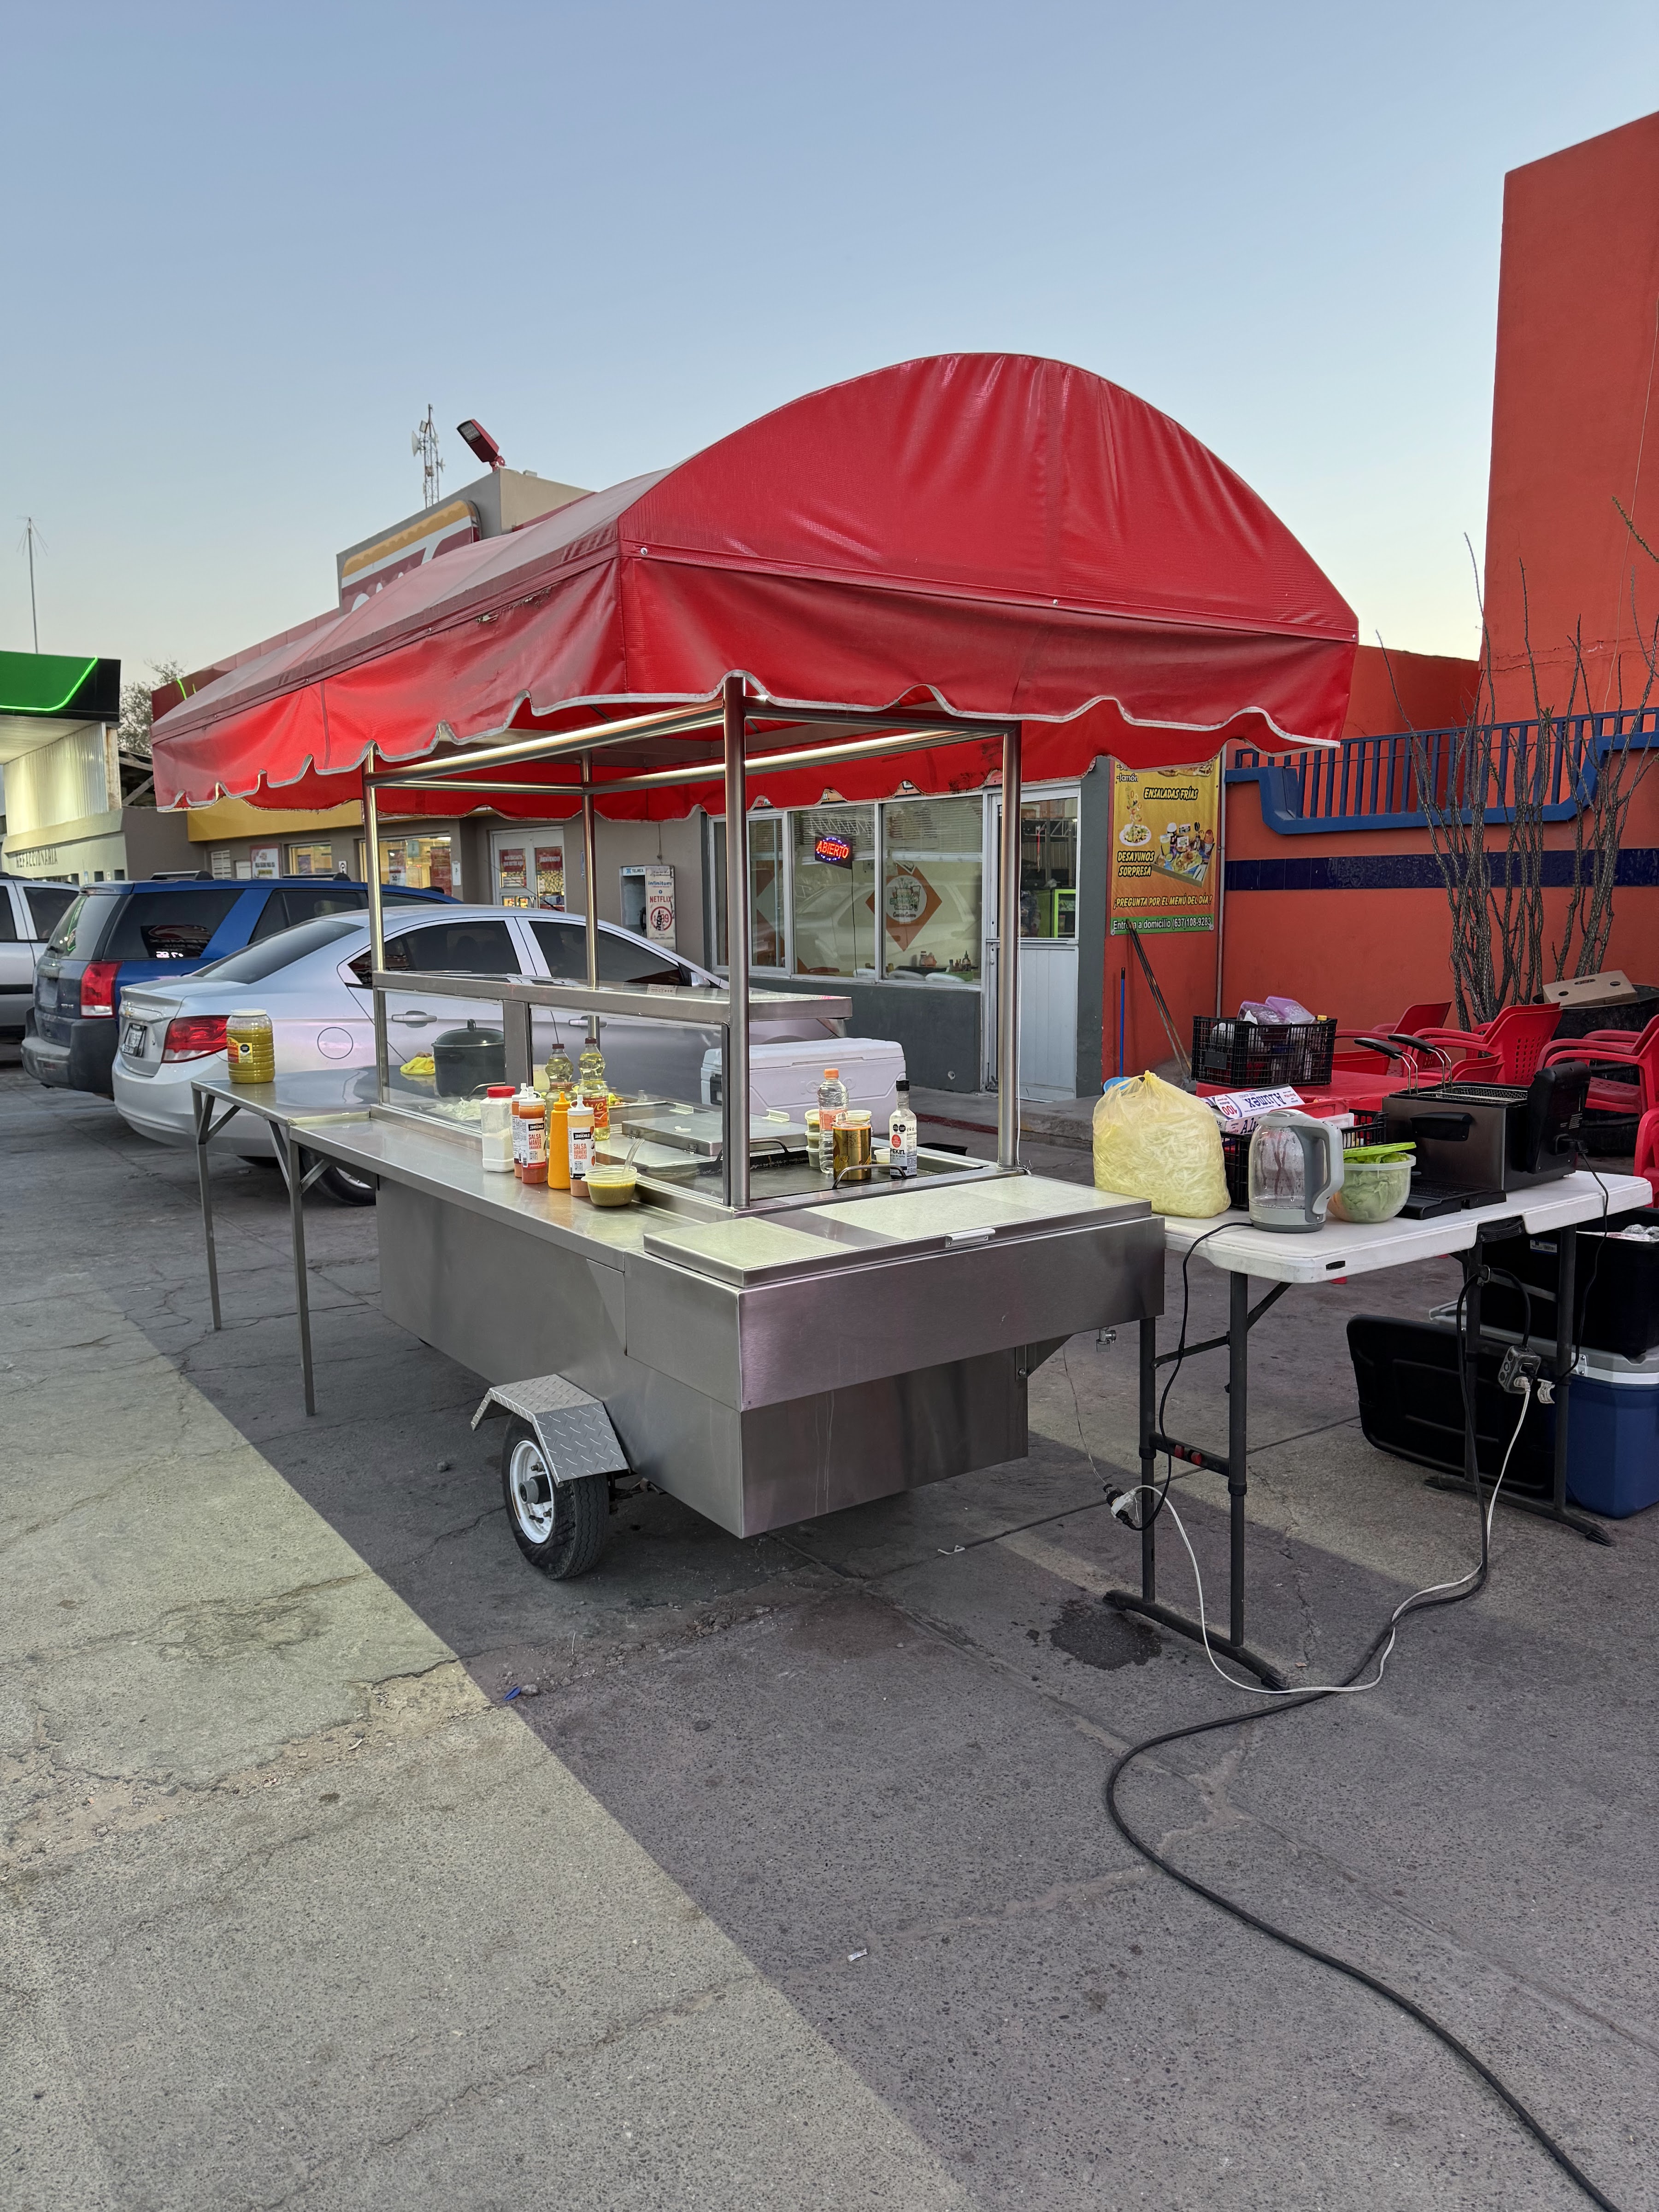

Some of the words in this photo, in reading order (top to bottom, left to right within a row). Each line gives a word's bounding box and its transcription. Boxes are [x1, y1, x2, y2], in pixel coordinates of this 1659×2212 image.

[1144, 787, 1180, 800] ENSALADAS
[1180, 786, 1198, 800] FRÍAS
[816, 841, 849, 859] ABIERTO
[1118, 851, 1155, 863] DESAYUNOS
[16, 848, 58, 868] REFACCIONARIA
[1118, 865, 1152, 877] SORPRESA
[1113, 897, 1147, 909] ¡PREGUNTA
[1148, 896, 1161, 906] POR
[1161, 896, 1168, 906] EL
[1169, 893, 1187, 906] MENÚ
[1187, 895, 1198, 905] DEL
[1199, 893, 1209, 905] DÍA
[1143, 919, 1171, 929] domicilio
[1172, 917, 1212, 930] (637)108-9283
[800, 1077, 856, 1095] IGO
[1244, 1093, 1287, 1108] Alumex
[1222, 1105, 1237, 1115] 100
